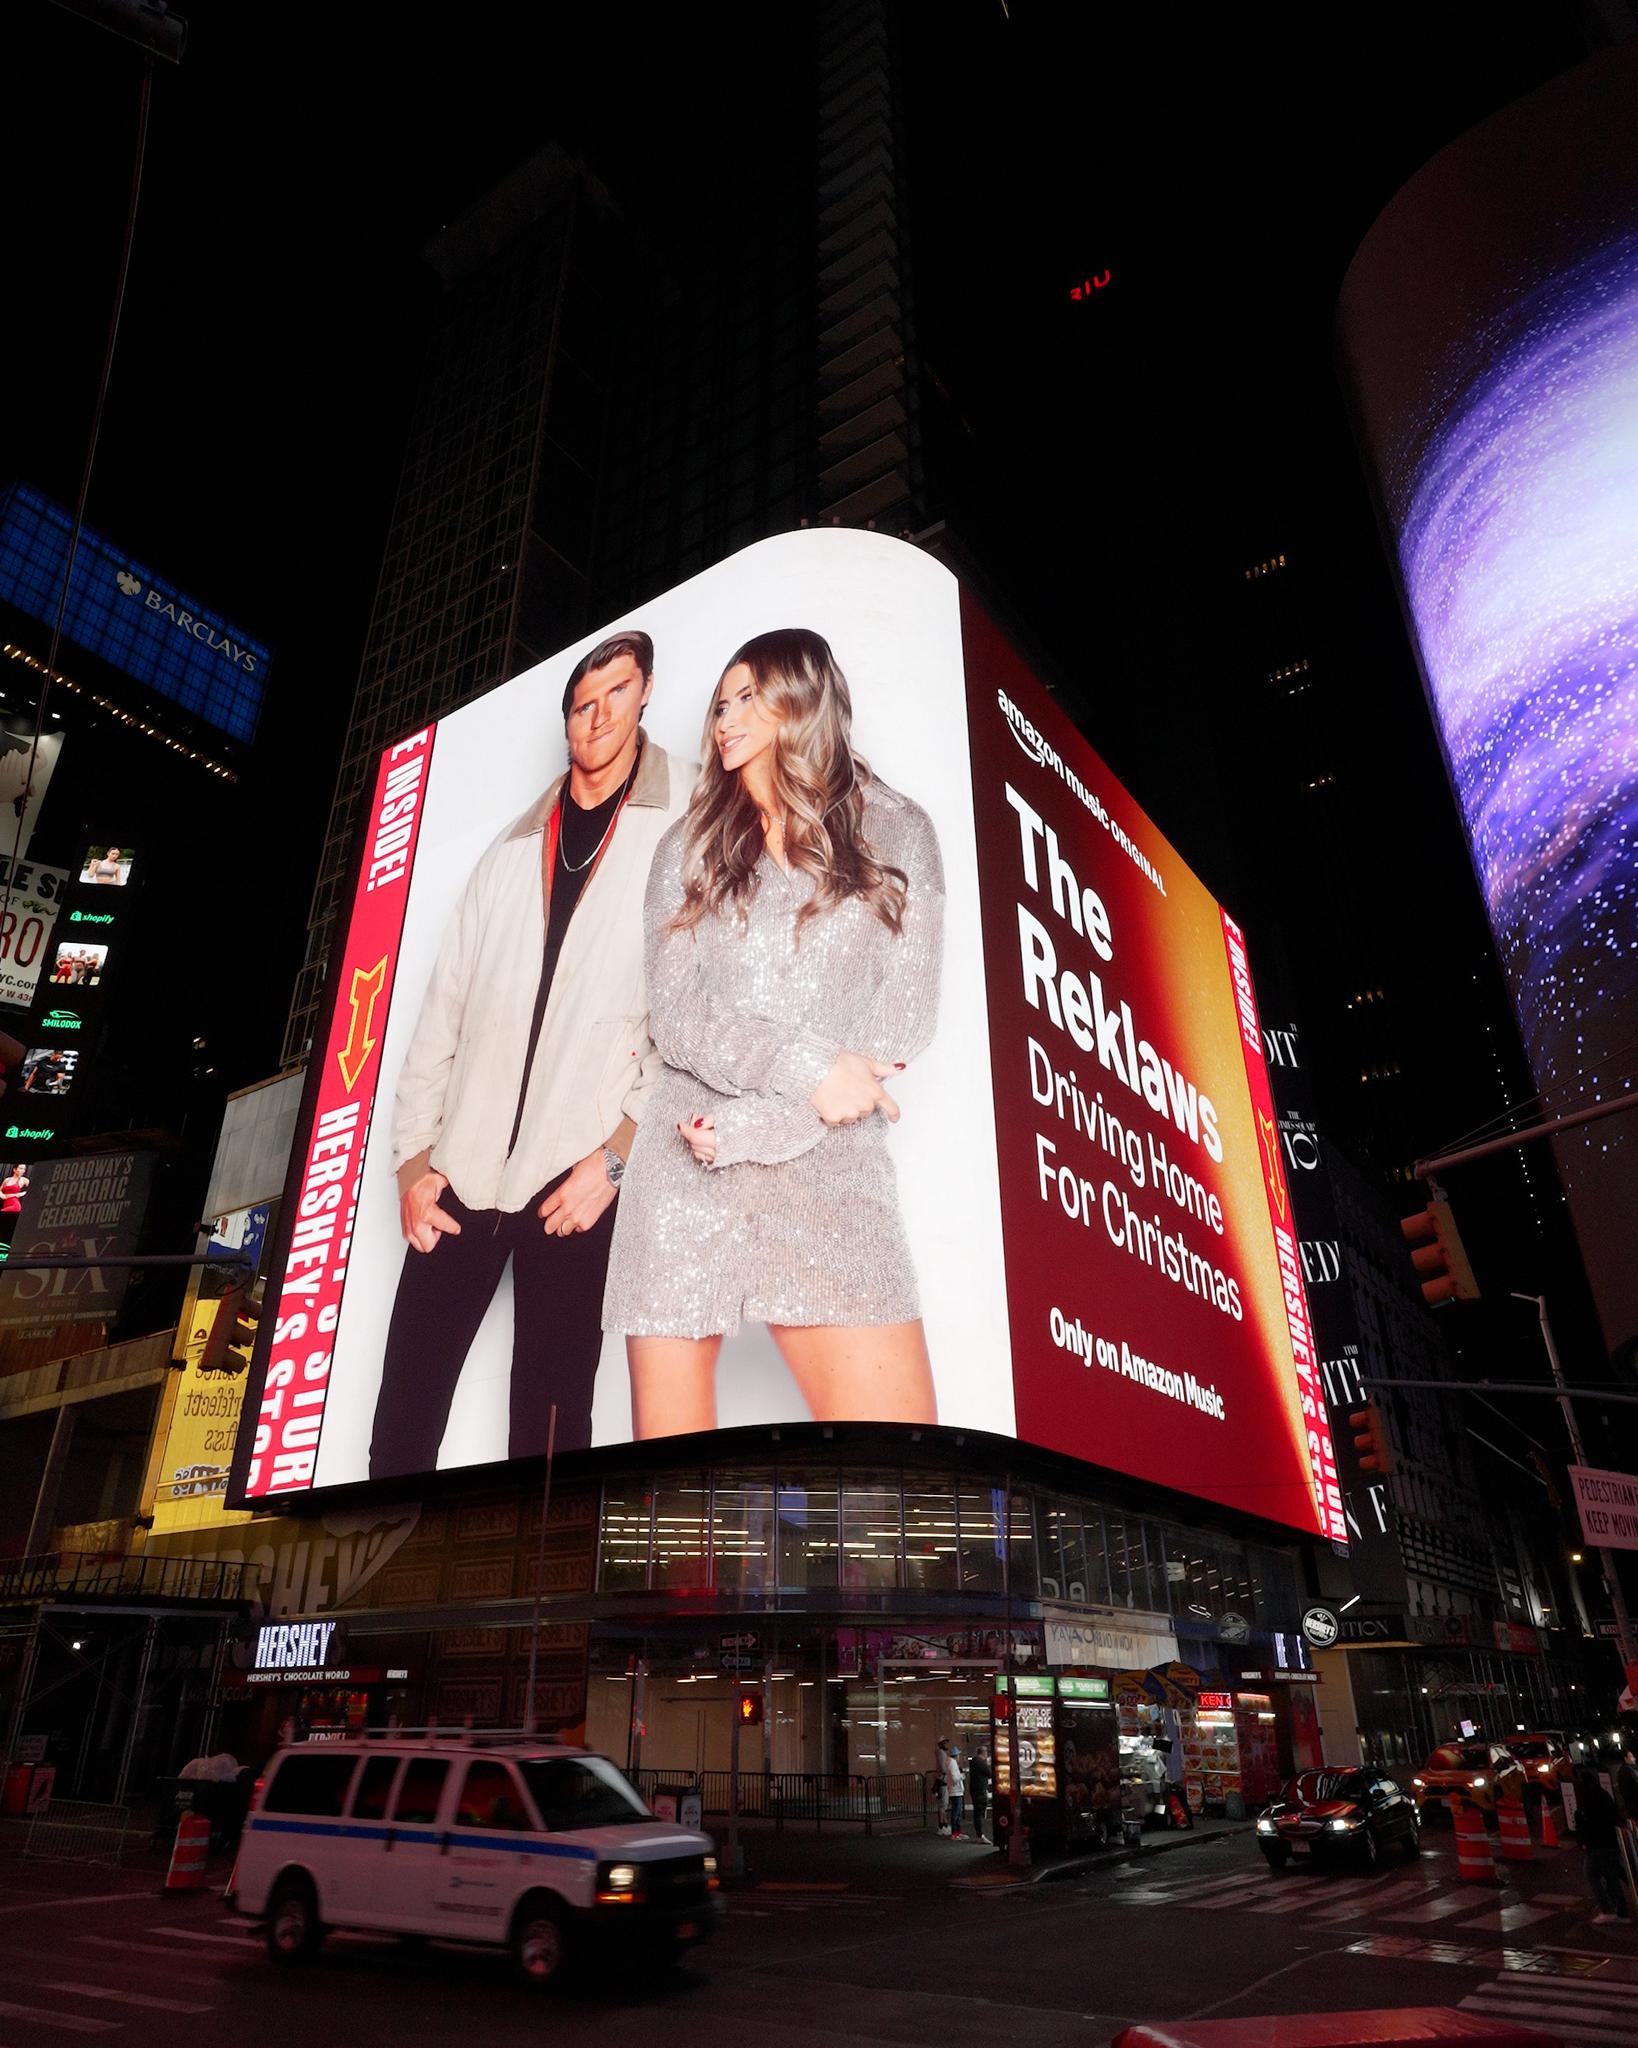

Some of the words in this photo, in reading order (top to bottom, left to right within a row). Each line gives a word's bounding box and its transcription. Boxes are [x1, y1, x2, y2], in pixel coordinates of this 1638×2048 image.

[145, 590, 257, 672] BARCLAYS
[366, 754, 424, 892] INSIDE!
[998, 688, 1064, 779] amazon
[1065, 765, 1110, 830] music
[1110, 819, 1167, 897] ORIGINAL
[82, 913, 115, 924] shopify
[1004, 781, 1113, 961] The
[42, 1019, 82, 1030] SMILODOX
[1017, 902, 1223, 1165] Reklaws
[1228, 935, 1262, 1056] INSIDE!
[19, 1128, 54, 1140] shopify
[52, 1156, 135, 1182] BROADWAY'S
[1028, 1035, 1145, 1188] Driving
[1147, 1132, 1223, 1235] Home
[13, 1236, 120, 1300] SIX
[274, 1101, 361, 1345] HERSHEY'S
[1036, 1133, 1096, 1227] For
[1102, 1181, 1243, 1321] Christmas
[1049, 1306, 1093, 1367] Only
[1095, 1337, 1120, 1372] on
[1120, 1341, 1184, 1403] Amazon
[1184, 1372, 1225, 1420] Music
[1275, 1226, 1316, 1419] HERSHEY'S
[1585, 1509, 1609, 1534] KEEP
[247, 1672, 281, 1683] HERSHEY'S
[283, 1671, 324, 1682] CHOCOLATE
[325, 1670, 350, 1680] WORLD
